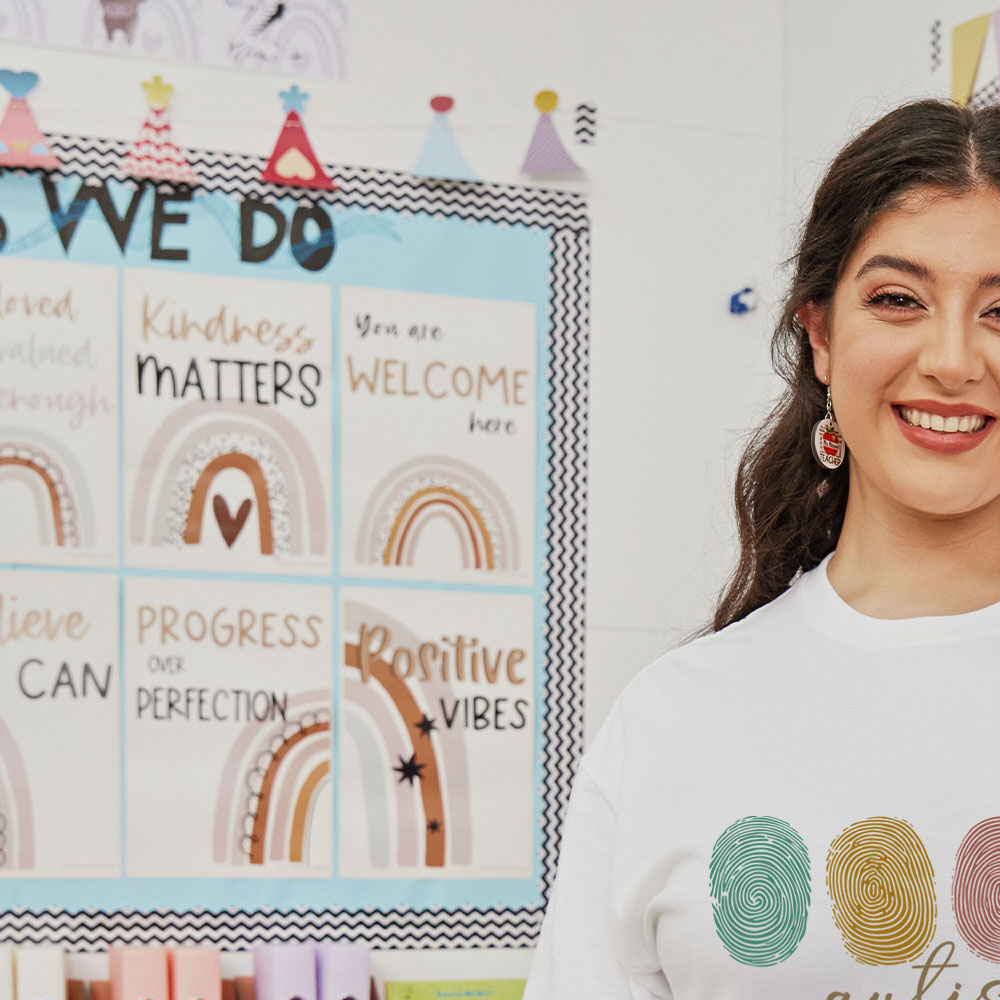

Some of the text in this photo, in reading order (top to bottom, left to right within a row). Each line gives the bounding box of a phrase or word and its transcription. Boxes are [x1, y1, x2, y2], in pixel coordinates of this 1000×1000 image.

[41, 172, 192, 262] WE
[240, 195, 335, 271] DO
[142, 295, 314, 354] Kindness
[355, 313, 442, 342] You are
[347, 354, 529, 405] WELCOME
[468, 410, 517, 435] here
[138, 605, 322, 648] PROGRESS
[149, 655, 185, 673] OVER
[359, 623, 527, 684] Positive
[18, 658, 112, 699] CAN
[137, 687, 288, 722] PERFECTION
[439, 696, 528, 731] VIBES
